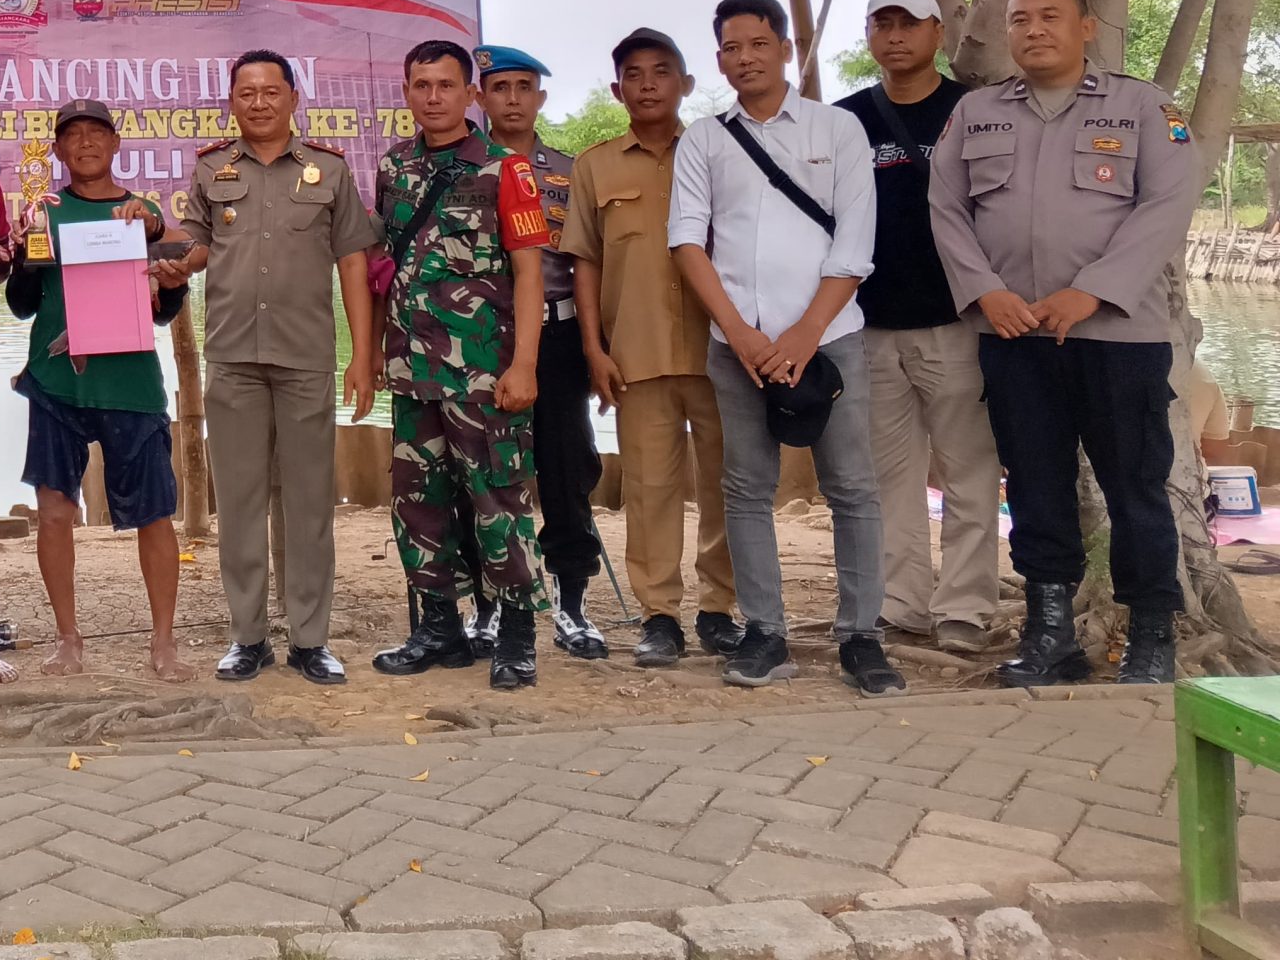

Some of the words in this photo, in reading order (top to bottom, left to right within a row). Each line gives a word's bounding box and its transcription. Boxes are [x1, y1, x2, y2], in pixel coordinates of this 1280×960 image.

[194, 56, 319, 101] IN
[967, 123, 1012, 134] UMITO
[1083, 118, 1135, 130] POLRI
